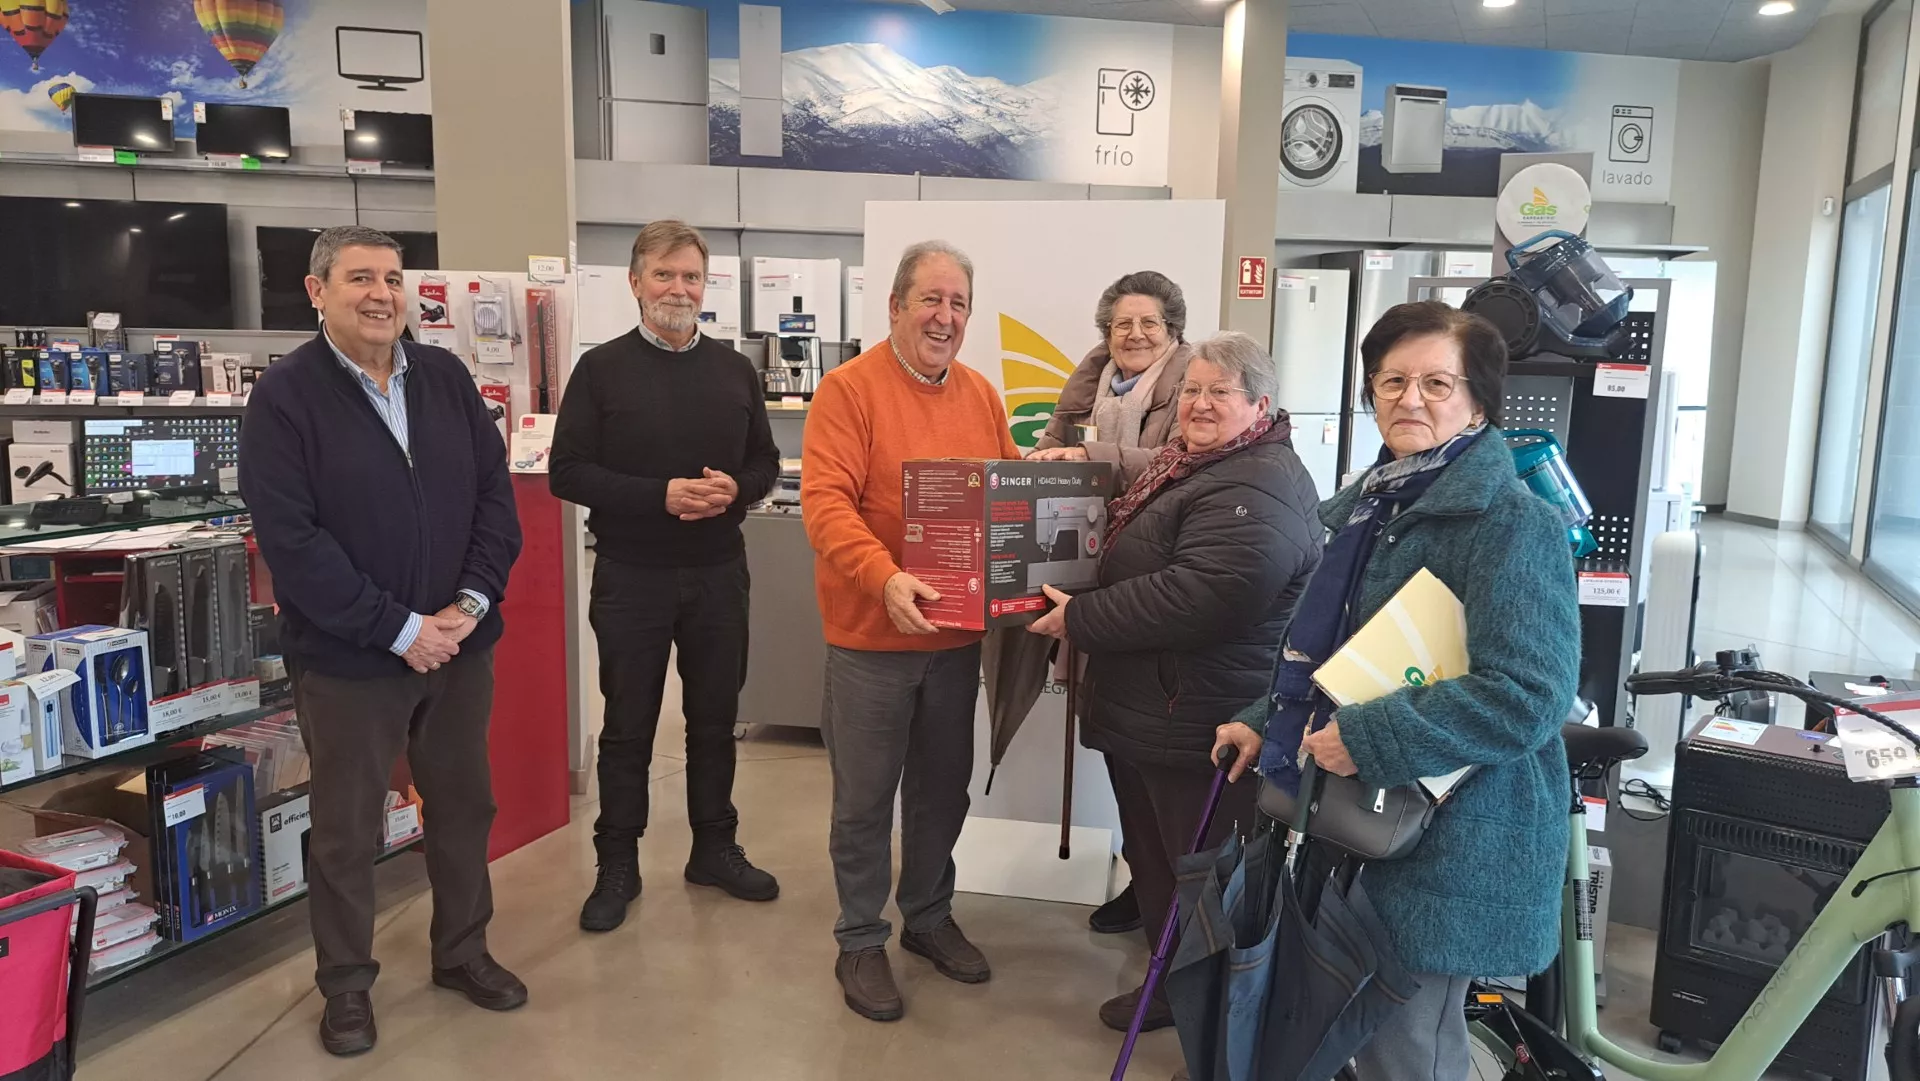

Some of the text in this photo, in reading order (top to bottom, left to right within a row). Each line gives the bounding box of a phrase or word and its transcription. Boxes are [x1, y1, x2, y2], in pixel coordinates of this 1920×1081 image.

[1095, 144, 1134, 167] frío
[1602, 169, 1653, 186] lavado
[1519, 202, 1558, 216] Gas
[1000, 477, 1032, 486] SINGER
[1057, 477, 1071, 486] Heavy
[1072, 477, 1083, 486] Duty
[213, 904, 238, 919] MONIX
